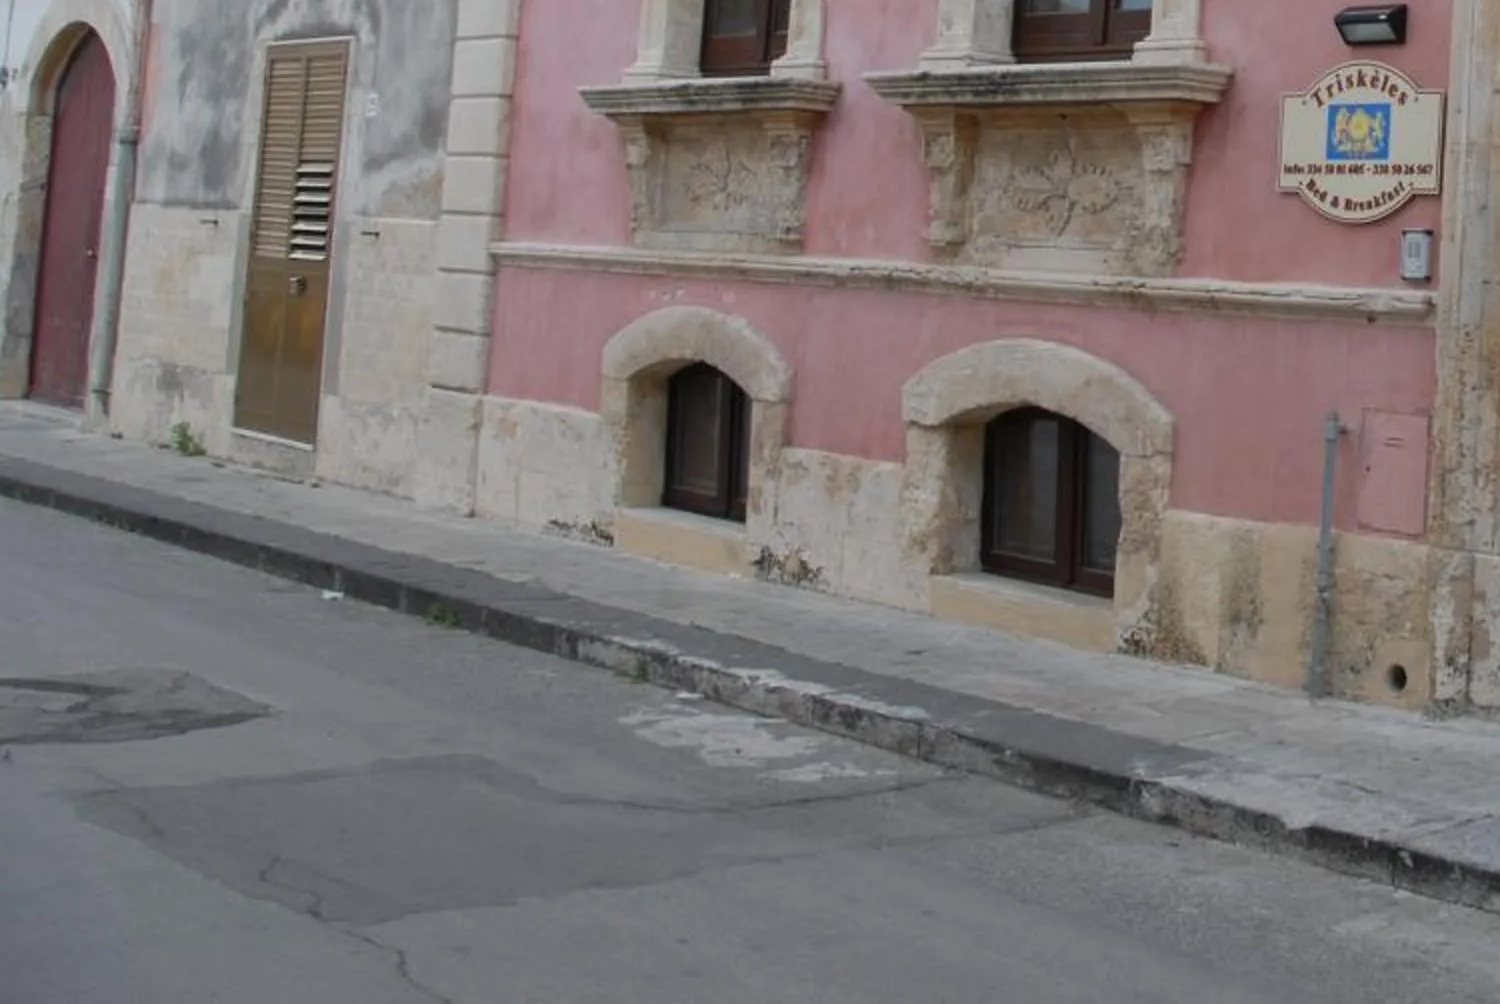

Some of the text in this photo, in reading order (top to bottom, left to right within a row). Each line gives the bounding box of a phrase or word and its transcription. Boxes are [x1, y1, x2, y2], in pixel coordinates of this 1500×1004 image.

[1306, 178, 1405, 212] Bed & Breakfast
